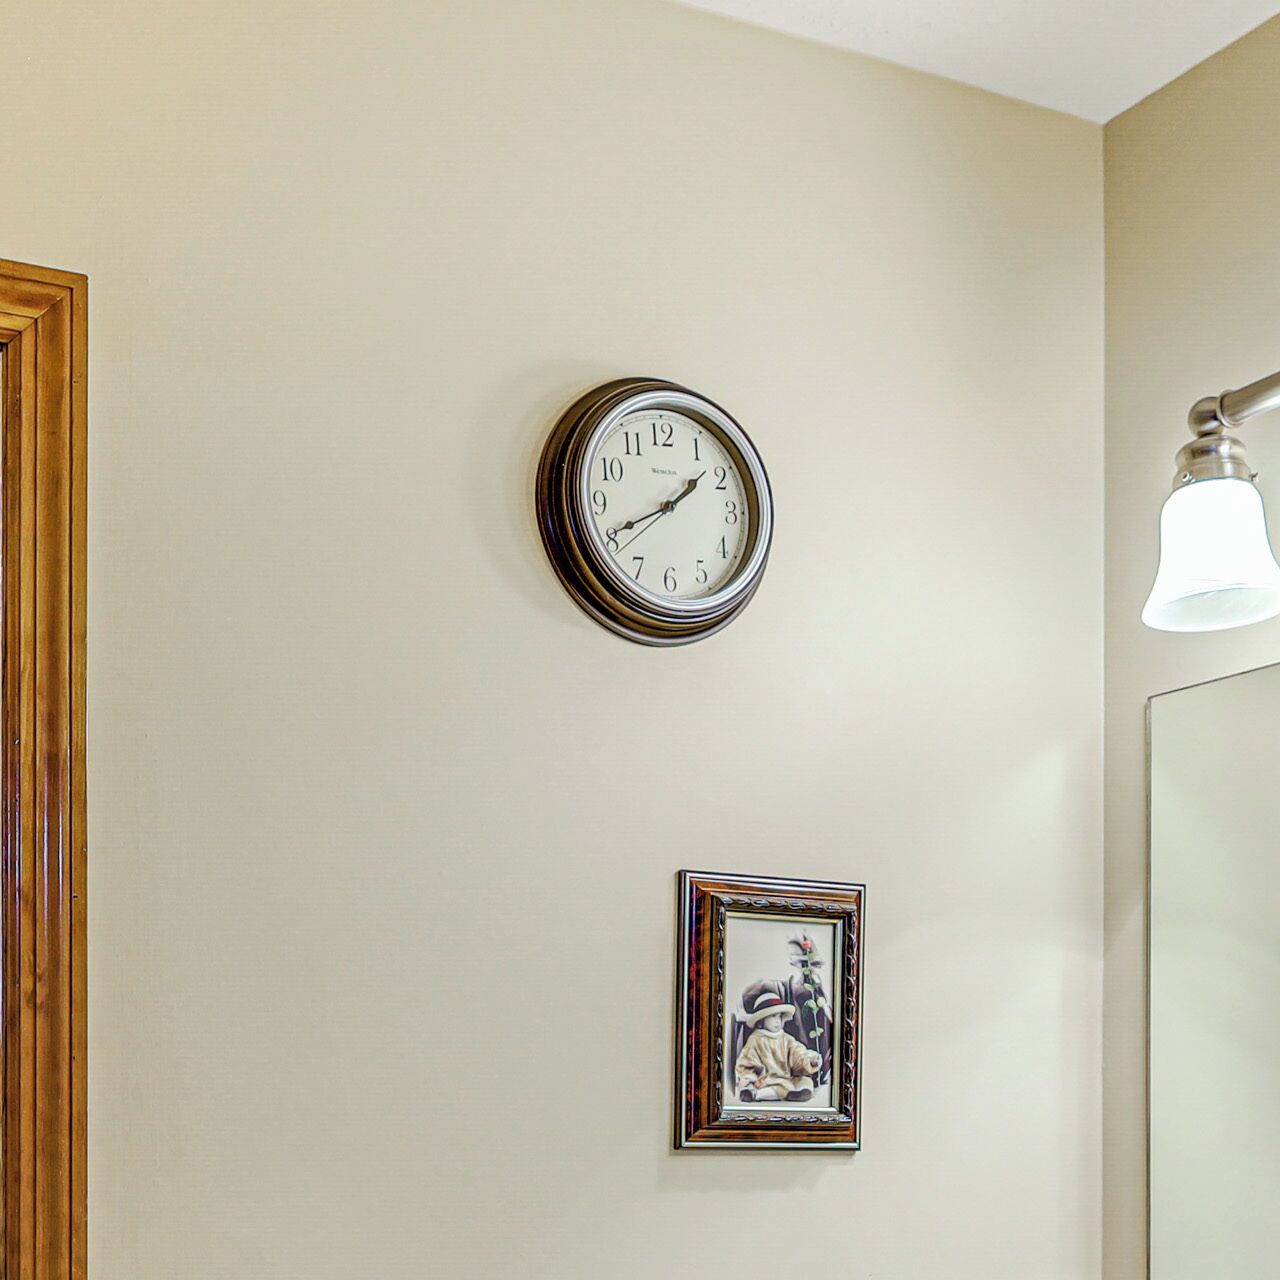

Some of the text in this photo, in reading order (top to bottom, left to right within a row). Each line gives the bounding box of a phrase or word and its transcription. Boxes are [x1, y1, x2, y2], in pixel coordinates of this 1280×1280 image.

[623, 431, 642, 457] 11
[651, 422, 674, 448] 12
[691, 437, 700, 461] 1
[600, 457, 623, 482] 10
[714, 466, 727, 490] 2
[593, 491, 607, 516] 9
[725, 501, 737, 525] 3
[606, 527, 619, 553] 8
[715, 535, 729, 559] 4
[632, 556, 644, 580] 7
[663, 567, 677, 592] 6
[695, 559, 708, 584] 5
